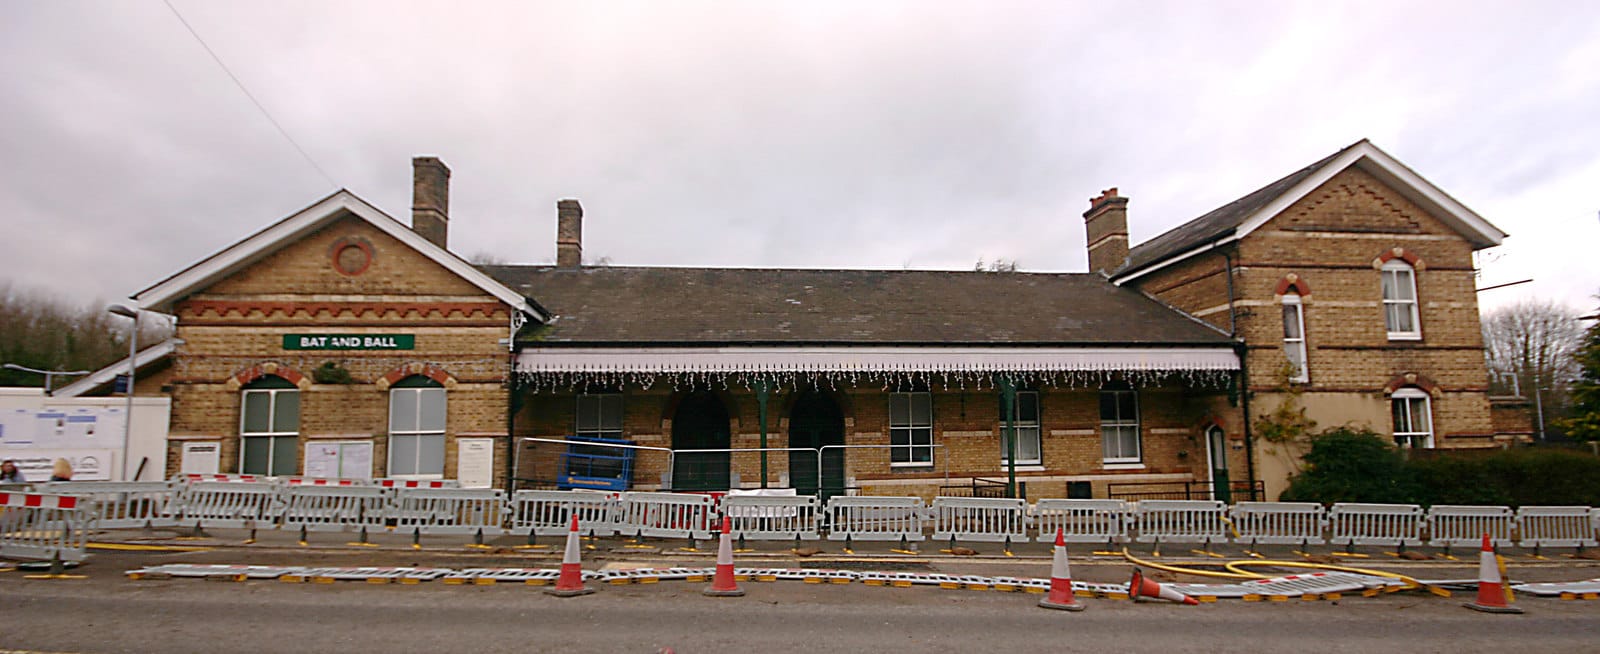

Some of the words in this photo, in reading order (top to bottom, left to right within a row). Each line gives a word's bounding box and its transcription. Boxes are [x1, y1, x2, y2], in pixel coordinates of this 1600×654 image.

[301, 337, 327, 347] BAT
[331, 337, 361, 347] AND
[364, 337, 397, 347] BALL
